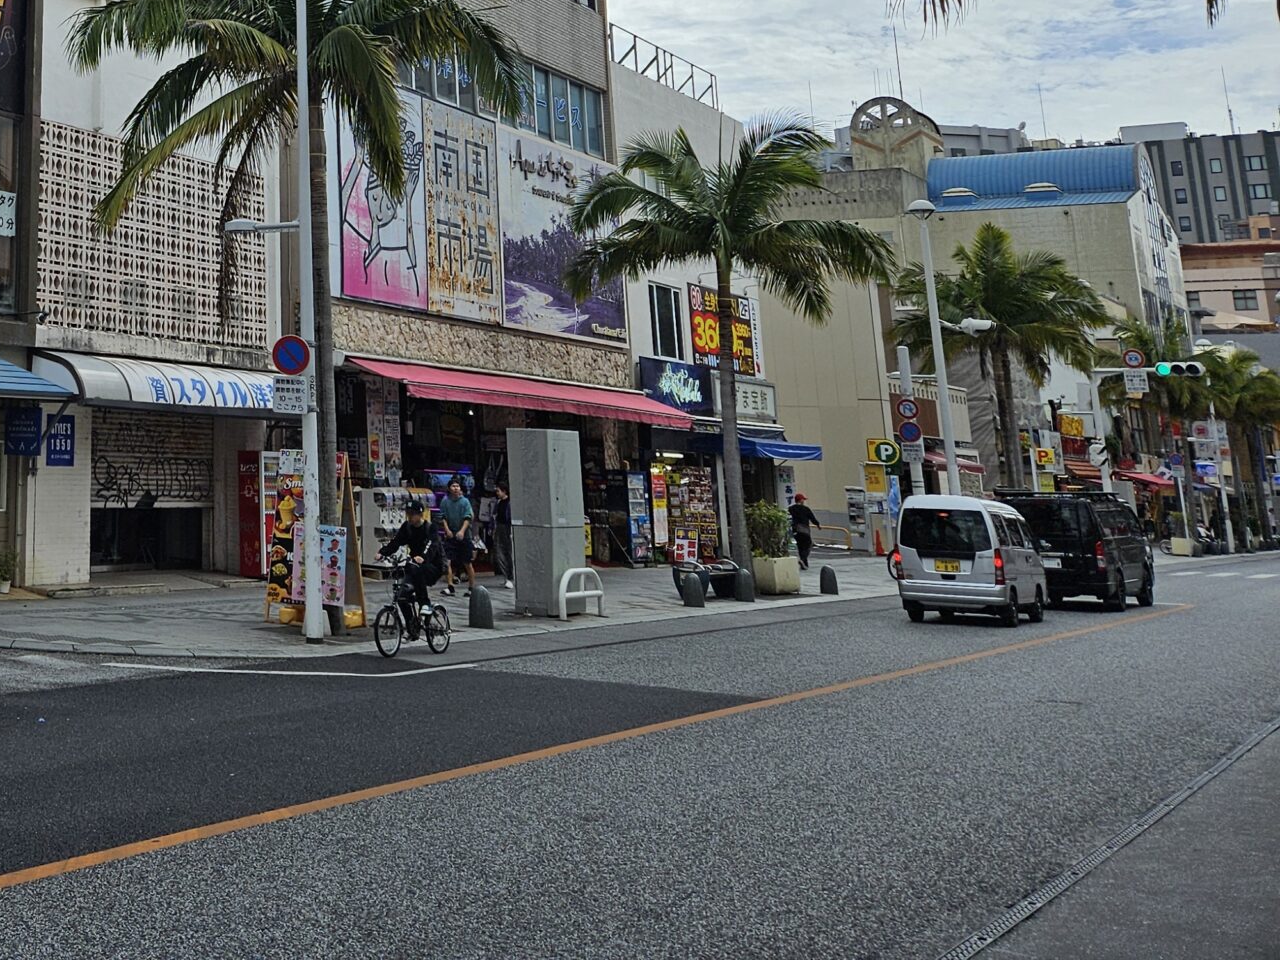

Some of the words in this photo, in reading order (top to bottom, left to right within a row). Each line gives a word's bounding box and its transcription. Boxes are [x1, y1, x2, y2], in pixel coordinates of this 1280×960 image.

[433, 128, 490, 199] 南国
[434, 190, 492, 216] NANGOKU
[436, 217, 494, 295] 市場
[276, 402, 304, 412] ここから
[51, 438, 71, 451] 1950
[879, 444, 894, 461] P
[1037, 450, 1049, 463] P
